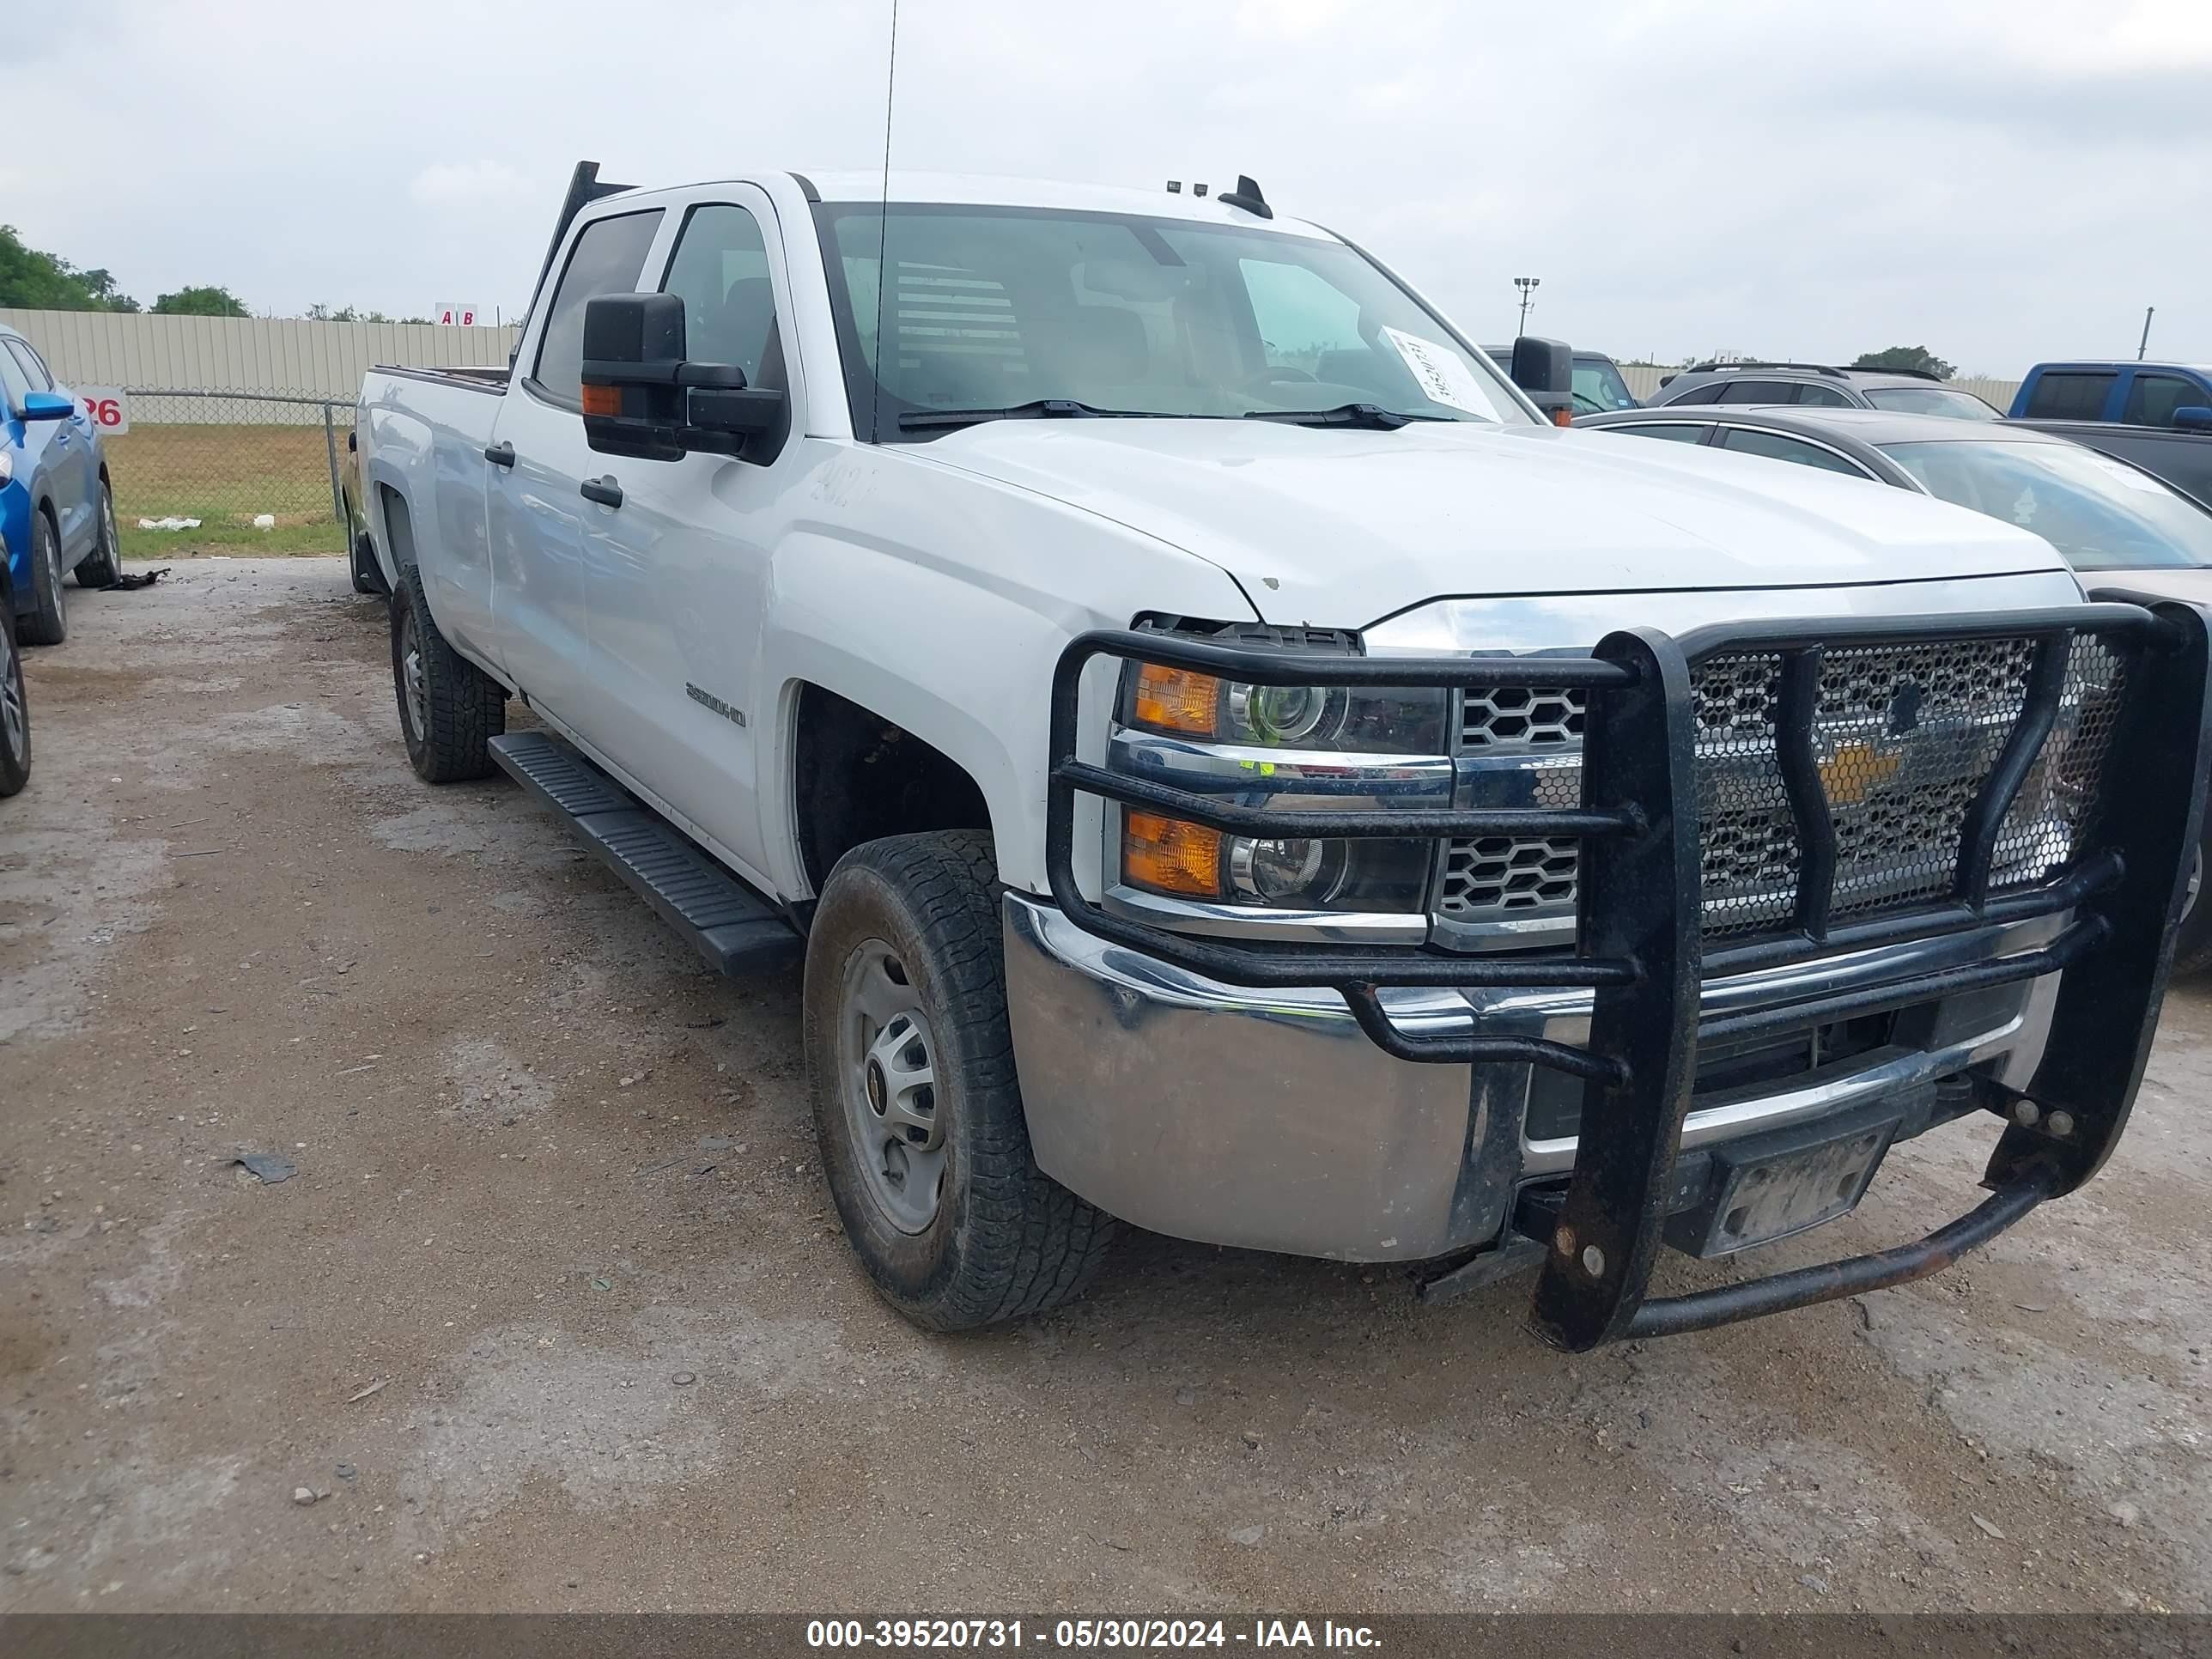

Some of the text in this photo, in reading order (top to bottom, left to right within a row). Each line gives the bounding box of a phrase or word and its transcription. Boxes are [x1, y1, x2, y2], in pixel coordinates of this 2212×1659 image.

[441, 311, 452, 325] A
[463, 312, 473, 325] B
[1407, 341, 1456, 402] 39520731
